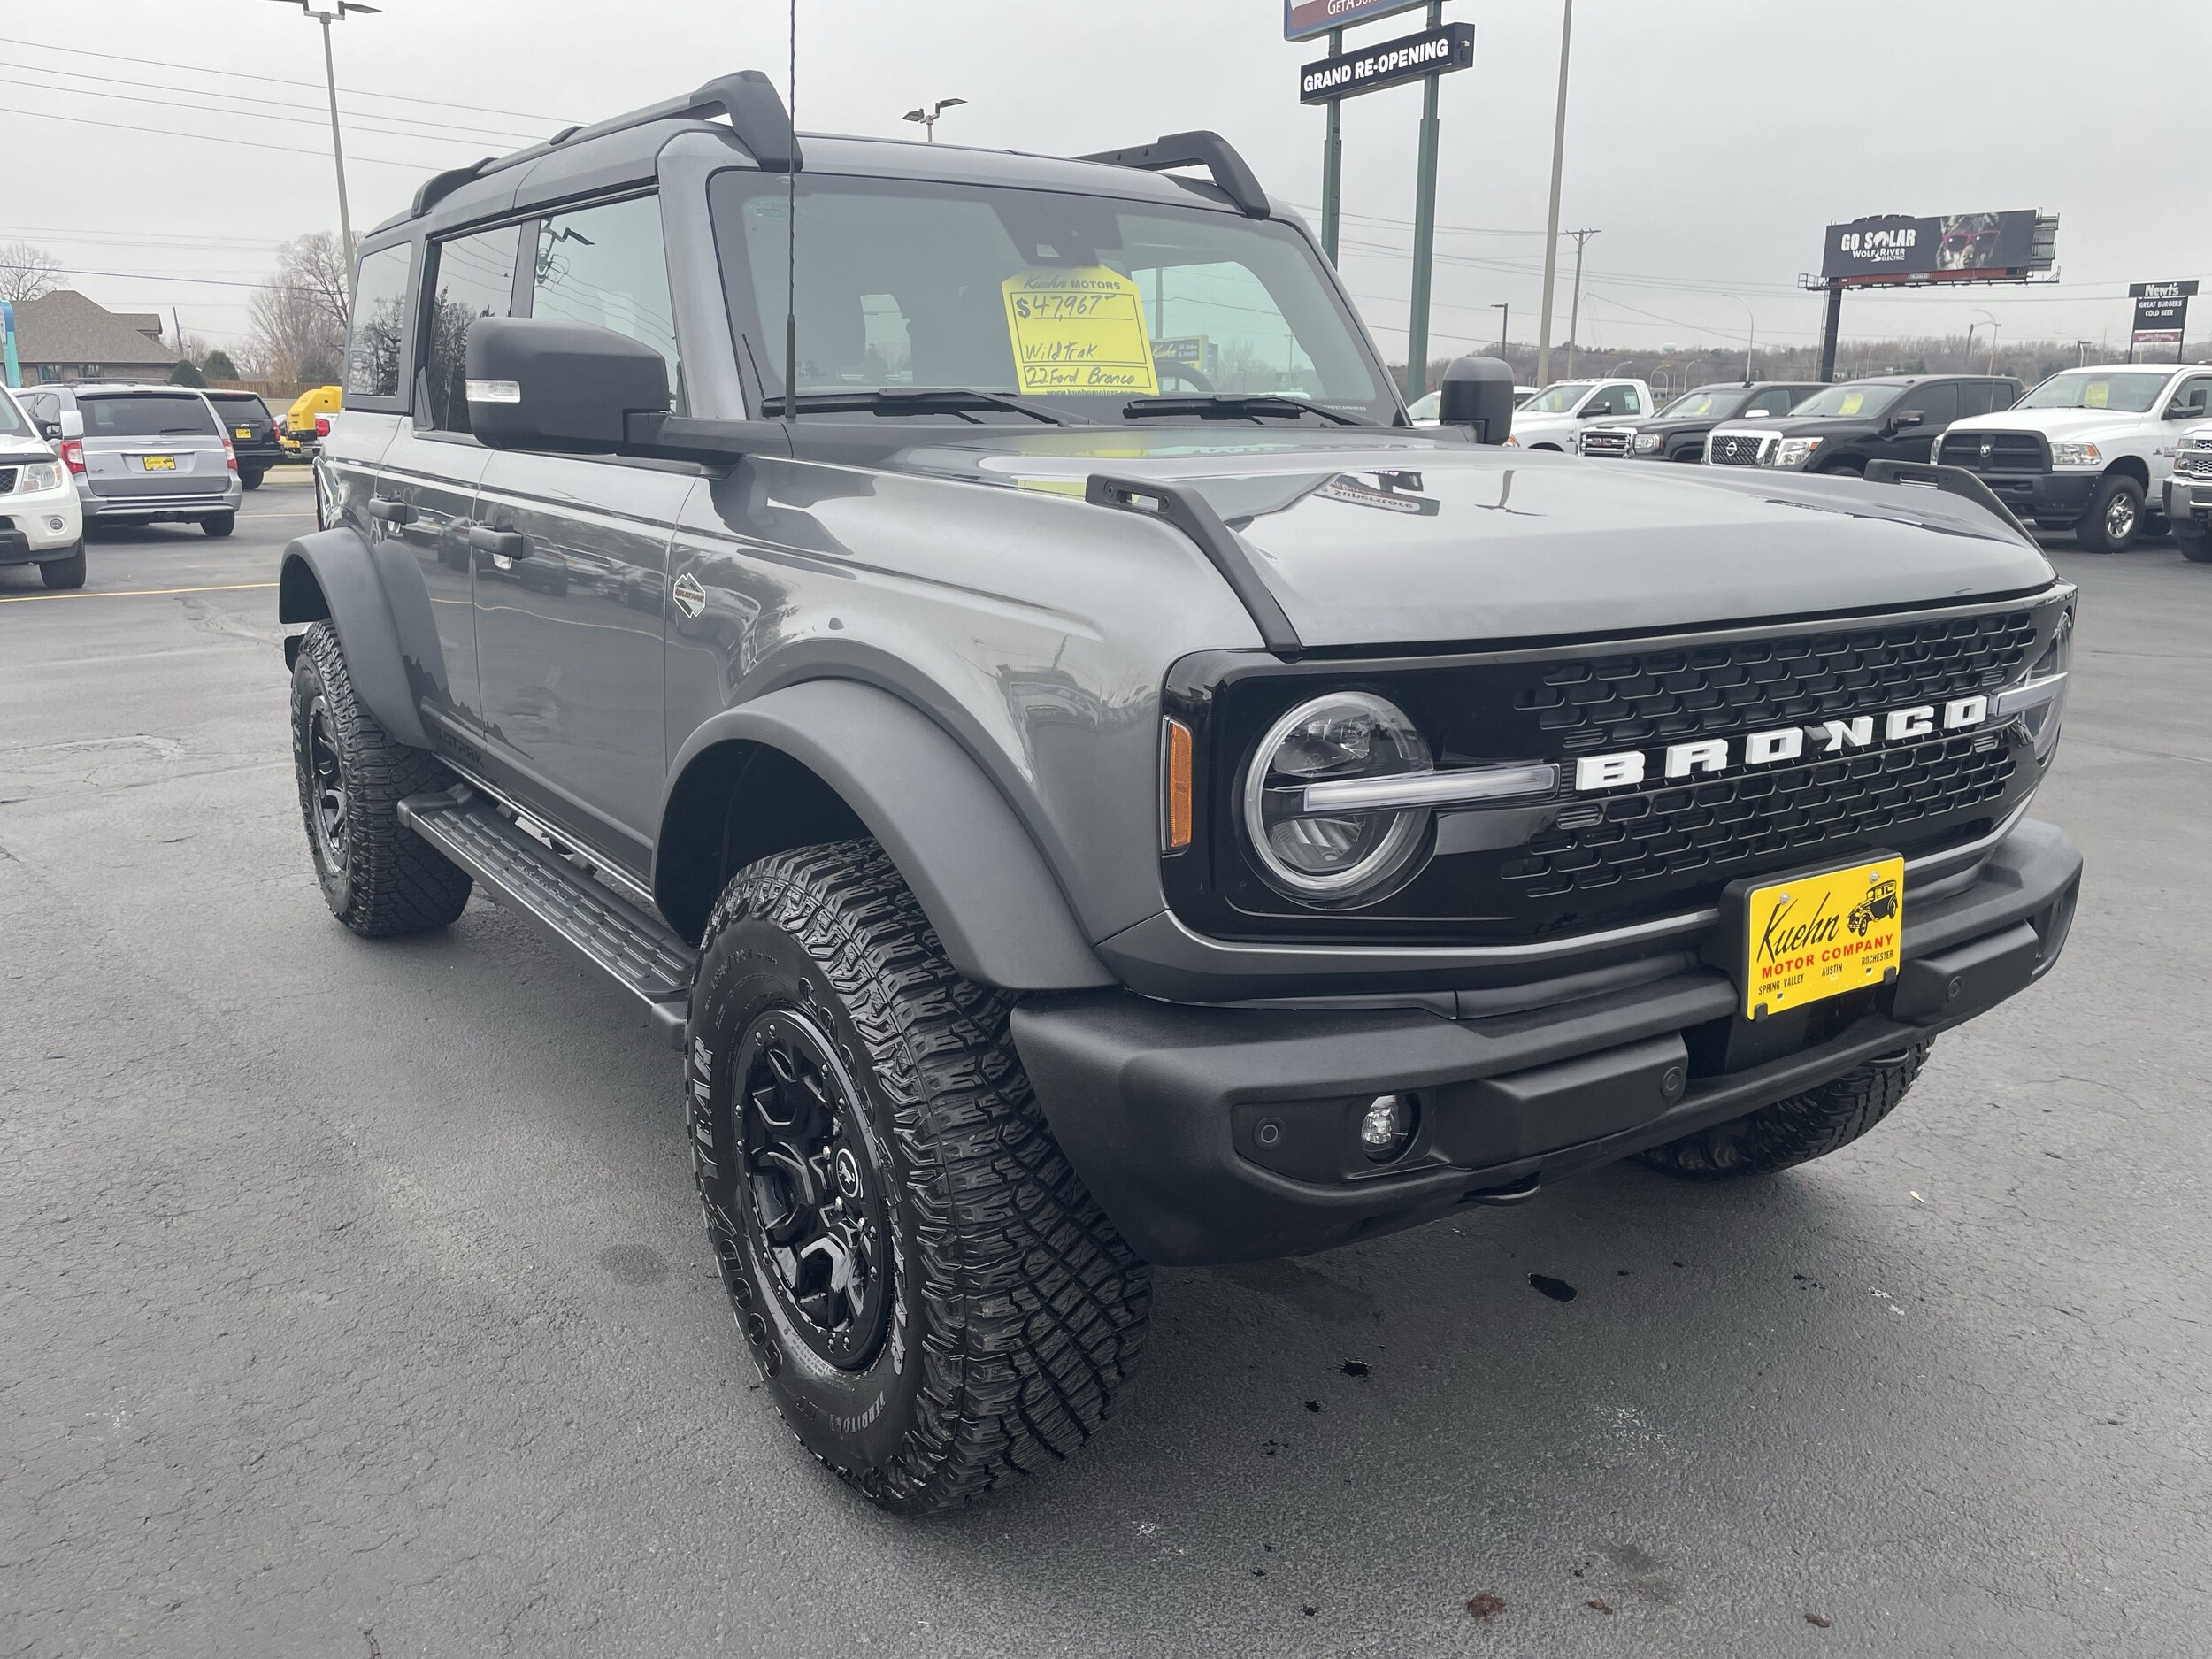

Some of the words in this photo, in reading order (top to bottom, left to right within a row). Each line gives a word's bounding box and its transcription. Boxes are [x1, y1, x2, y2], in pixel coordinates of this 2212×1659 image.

[1303, 65, 1351, 92] GRAND
[1355, 38, 1448, 80] RE-OPENING
[1841, 233, 1860, 251] GO
[1864, 229, 1916, 249] SOLAR
[1853, 250, 1875, 258] WOLF
[1879, 248, 1905, 257] RIVER
[1071, 280, 1121, 290] MOTORS
[2145, 282, 2179, 296] Newt's
[1087, 366, 1134, 385] Bronco
[1576, 695, 1988, 791] BRONCO
[1756, 891, 1840, 964] Kuehn
[1758, 981, 1780, 995] SPRING
[1783, 973, 1804, 988] VALLEY
[1822, 964, 1843, 977] AUSTIN
[1861, 949, 1893, 966] ROCHESTER
[1762, 954, 1815, 980] MOTOR
[1822, 933, 1894, 963] COMPANY
